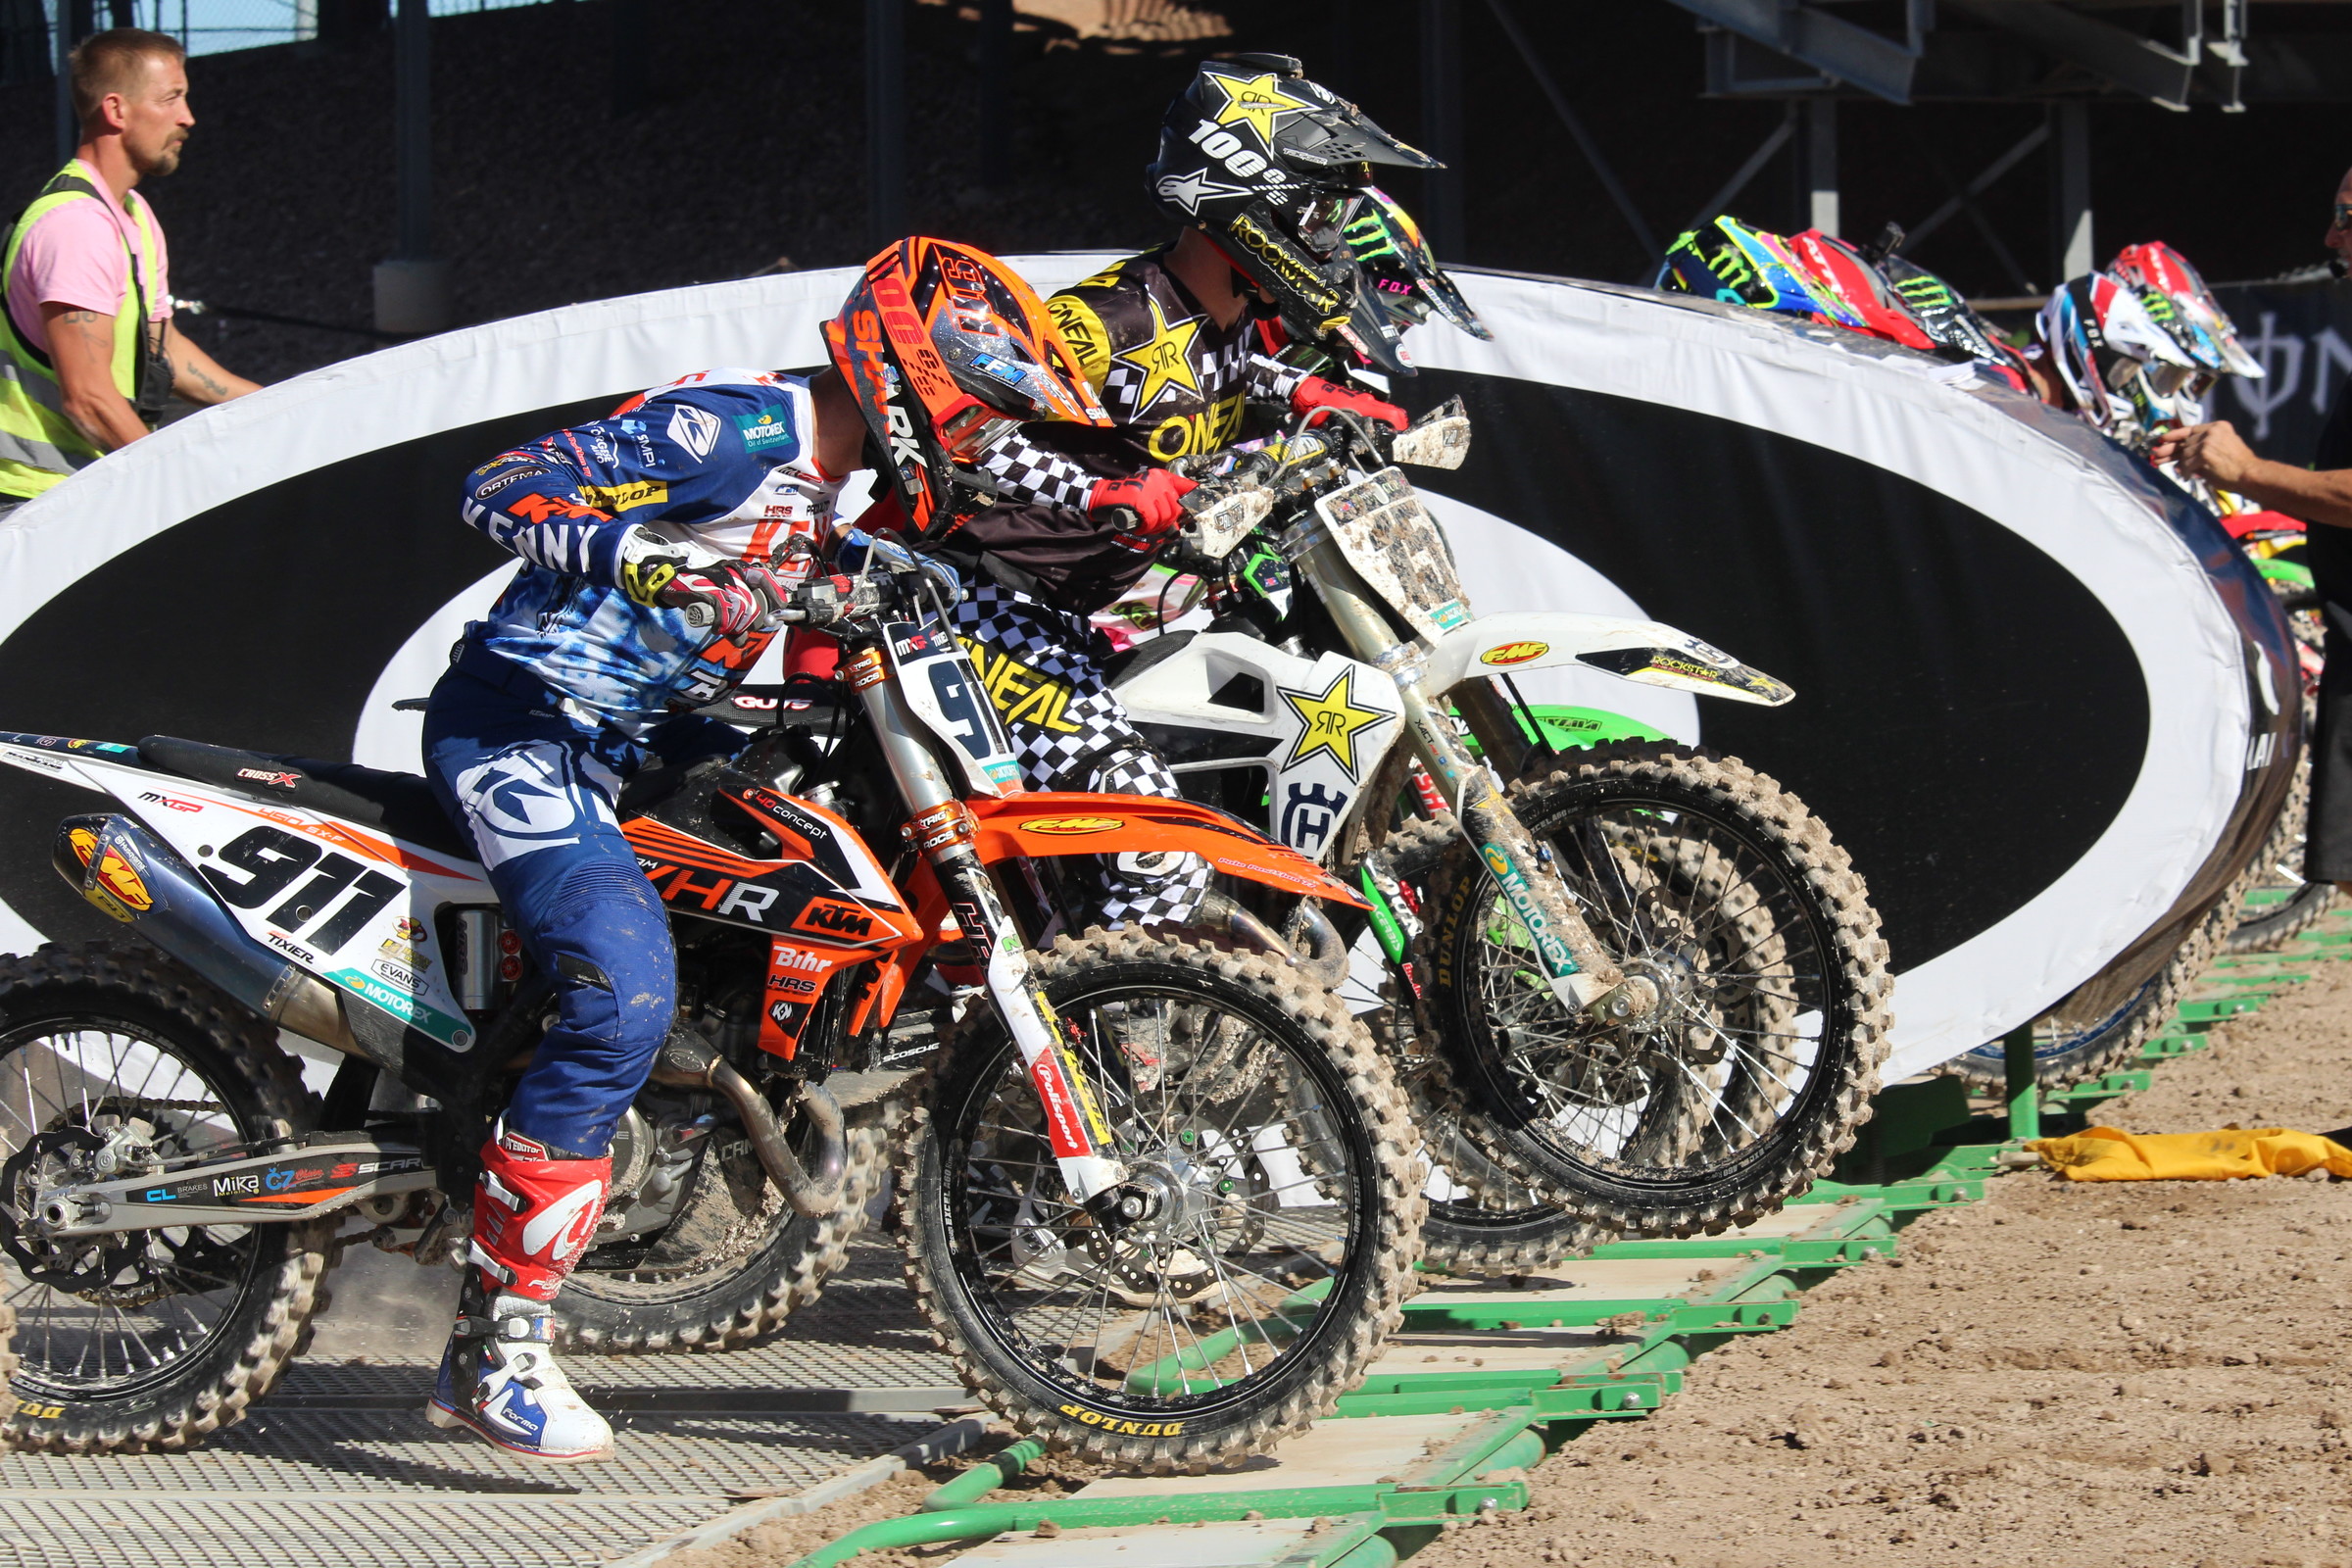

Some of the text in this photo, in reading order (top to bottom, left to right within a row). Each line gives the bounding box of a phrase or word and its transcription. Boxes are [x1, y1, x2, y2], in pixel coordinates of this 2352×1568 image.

[1188, 119, 1300, 206] 100%
[1378, 278, 1412, 296] FOX
[2083, 318, 2104, 348] FOX
[973, 354, 1026, 382] FFM
[743, 421, 785, 440] MOTOREX
[636, 434, 657, 467] SMPI
[480, 469, 543, 496] ORTEMA
[764, 505, 793, 514] HRS
[1482, 643, 1548, 663] FMF
[956, 637, 1082, 733] NEAL
[1414, 718, 1435, 744] XACT
[137, 792, 204, 812] MXGP
[912, 810, 947, 831] XTRIG
[70, 833, 154, 905] FMF
[120, 841, 148, 871] Husqvarna
[199, 826, 406, 956] 911
[804, 905, 874, 937] KTM
[1438, 876, 1471, 988] DUNLOP
[1501, 872, 1572, 974] MOTOREX
[269, 934, 315, 964] TIXIER
[773, 946, 833, 972] Bihr
[380, 963, 422, 990] EVANS
[767, 974, 817, 993] HRS
[365, 982, 432, 1024] MOTOREX
[883, 1042, 941, 1062] SCOSCHE
[1037, 1064, 1078, 1150] Polisport
[146, 1189, 176, 1202] CL
[176, 1183, 208, 1193] BRAKES
[213, 1174, 260, 1197] Mika
[944, 1191, 954, 1226] EXCEL
[1059, 1404, 1186, 1437] DUNLOP
